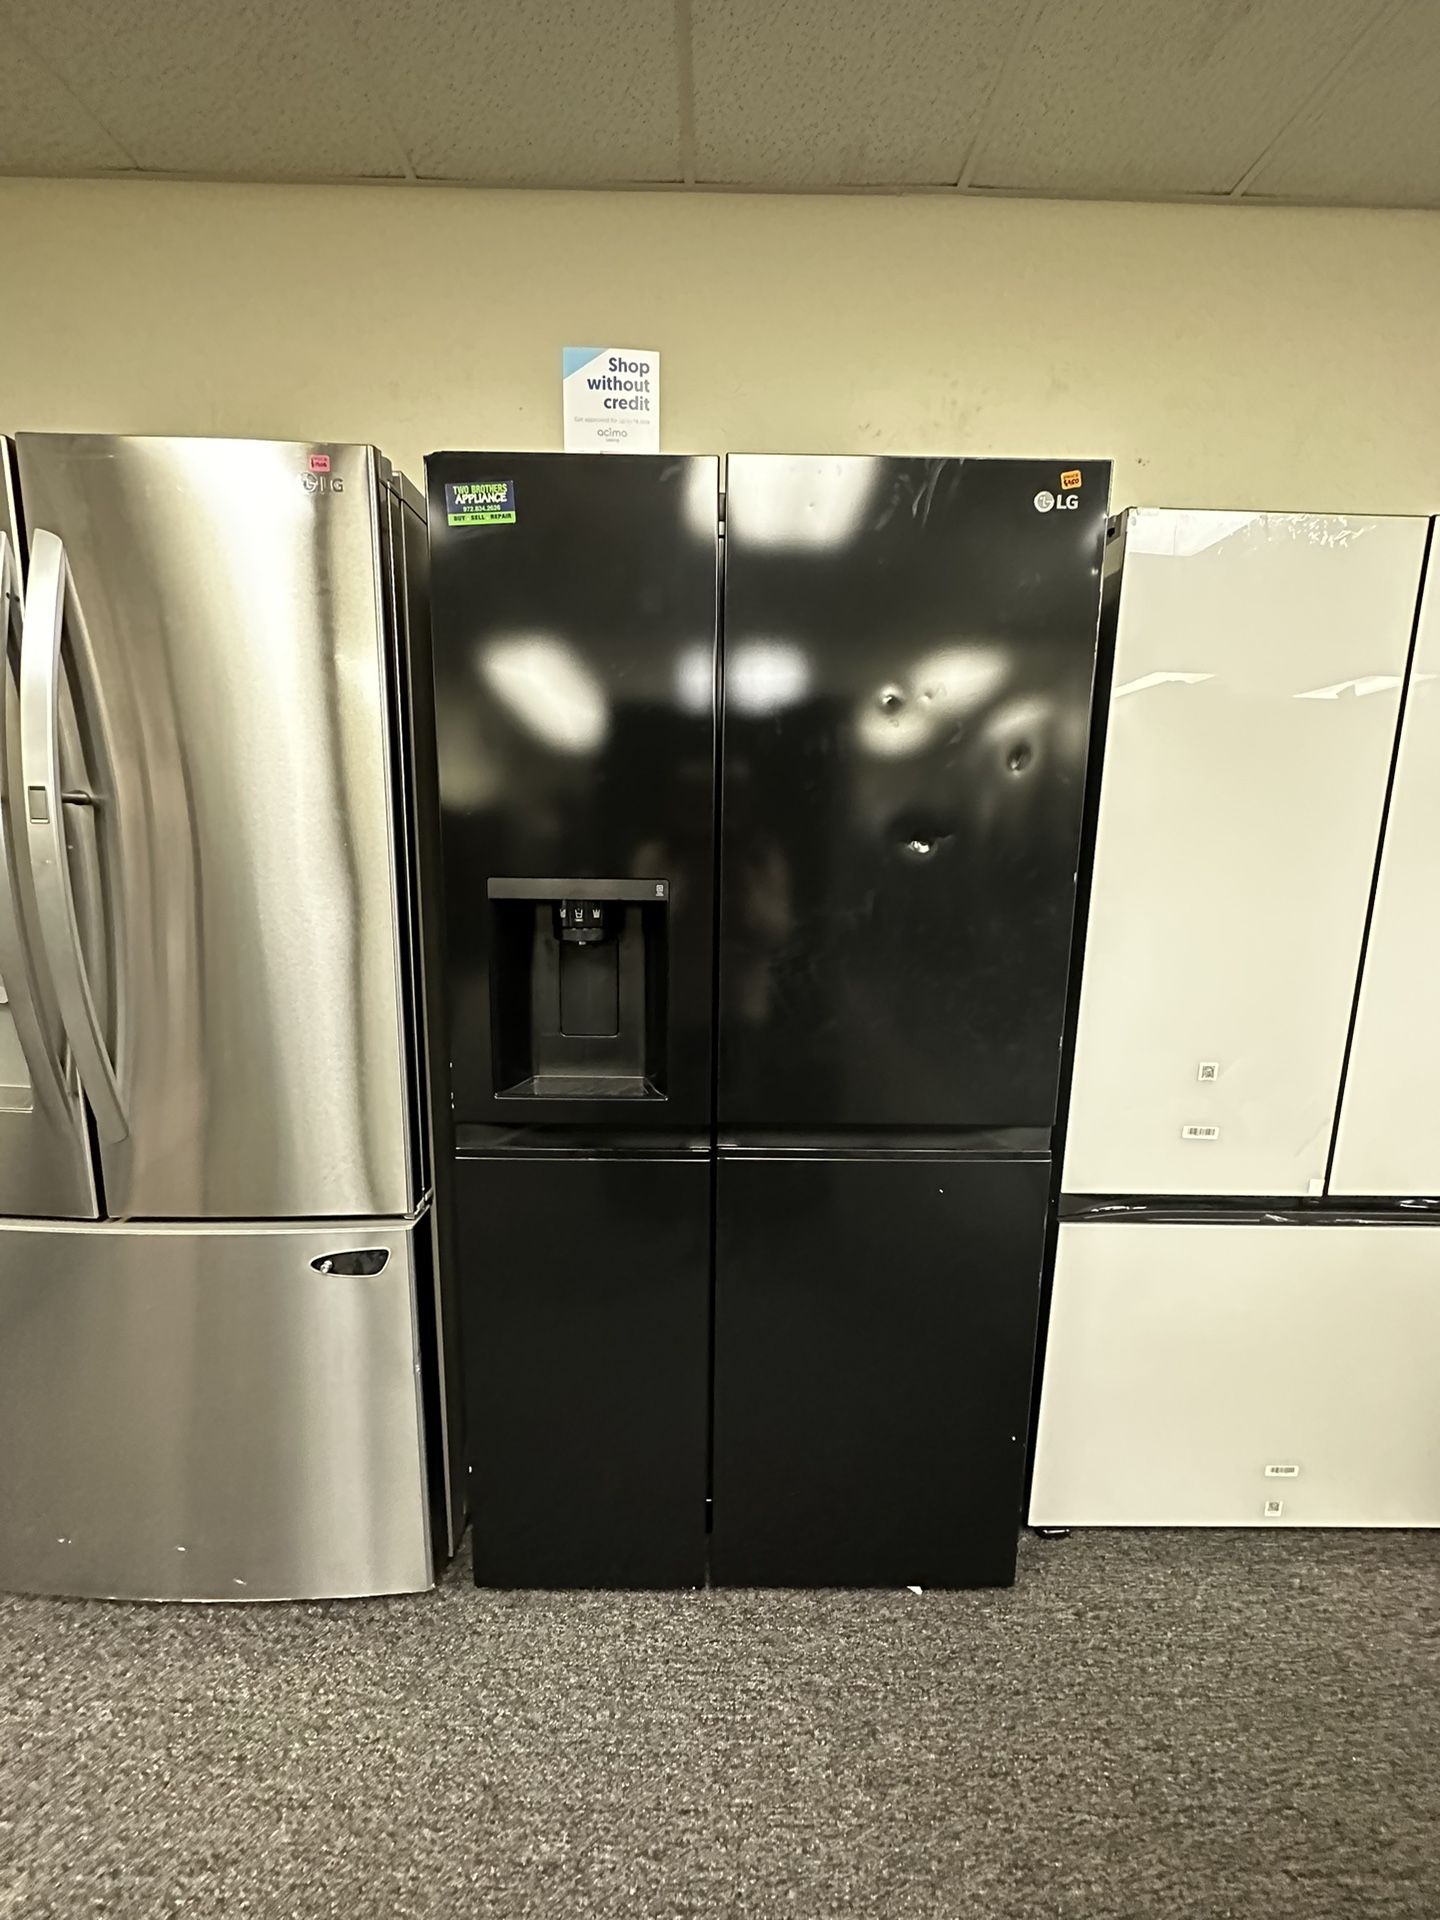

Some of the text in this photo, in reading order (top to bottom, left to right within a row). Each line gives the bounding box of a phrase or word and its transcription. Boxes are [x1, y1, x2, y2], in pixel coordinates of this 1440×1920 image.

[608, 357, 650, 377] Shop
[587, 375, 650, 393] without
[603, 395, 650, 411] credit
[453, 483, 508, 495] TWO BROTHERS
[455, 492, 508, 504] APPLIANCE
[1056, 494, 1079, 510] LG
